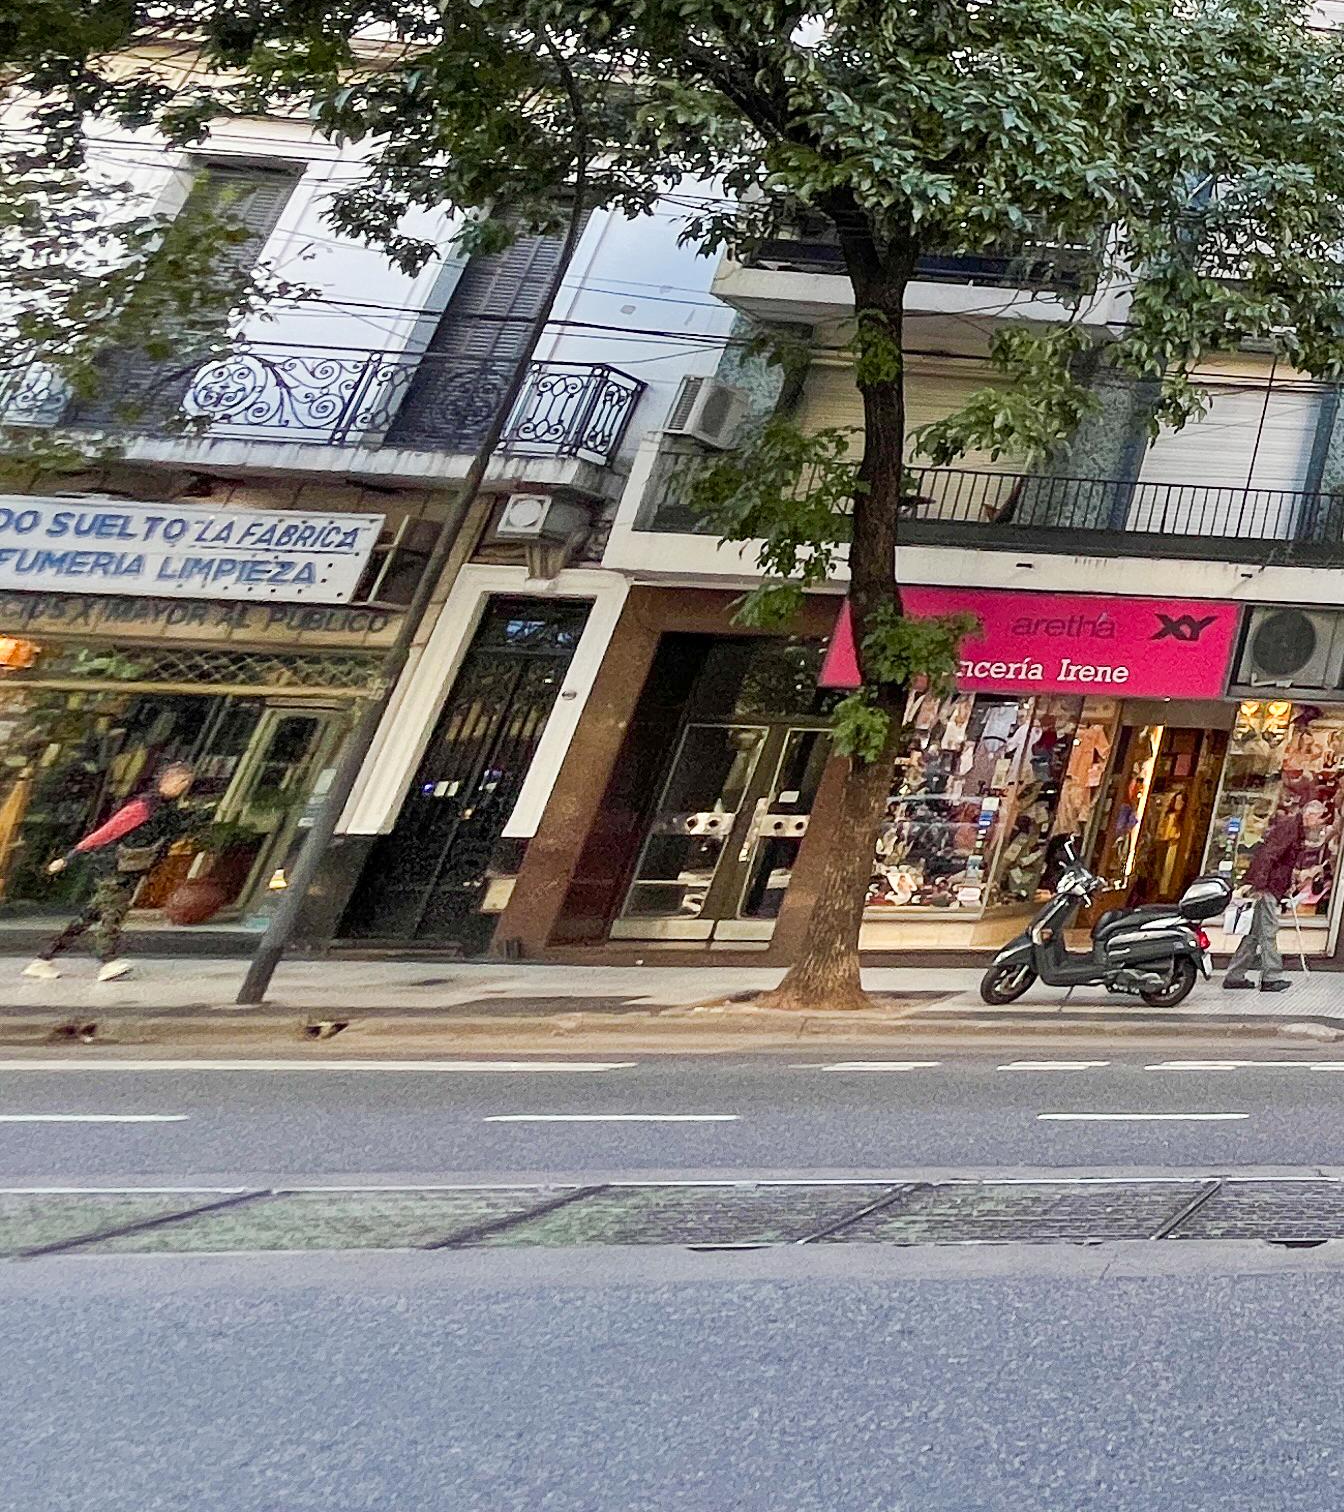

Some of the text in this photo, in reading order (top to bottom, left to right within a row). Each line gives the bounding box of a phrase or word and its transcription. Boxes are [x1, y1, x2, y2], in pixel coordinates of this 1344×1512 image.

[46, 511, 189, 544] SUELTO
[157, 555, 317, 586] LIMPIEZA
[265, 607, 390, 633] PUBLICO
[1010, 613, 1117, 639] aretha
[957, 657, 1129, 684] ncería Irene
